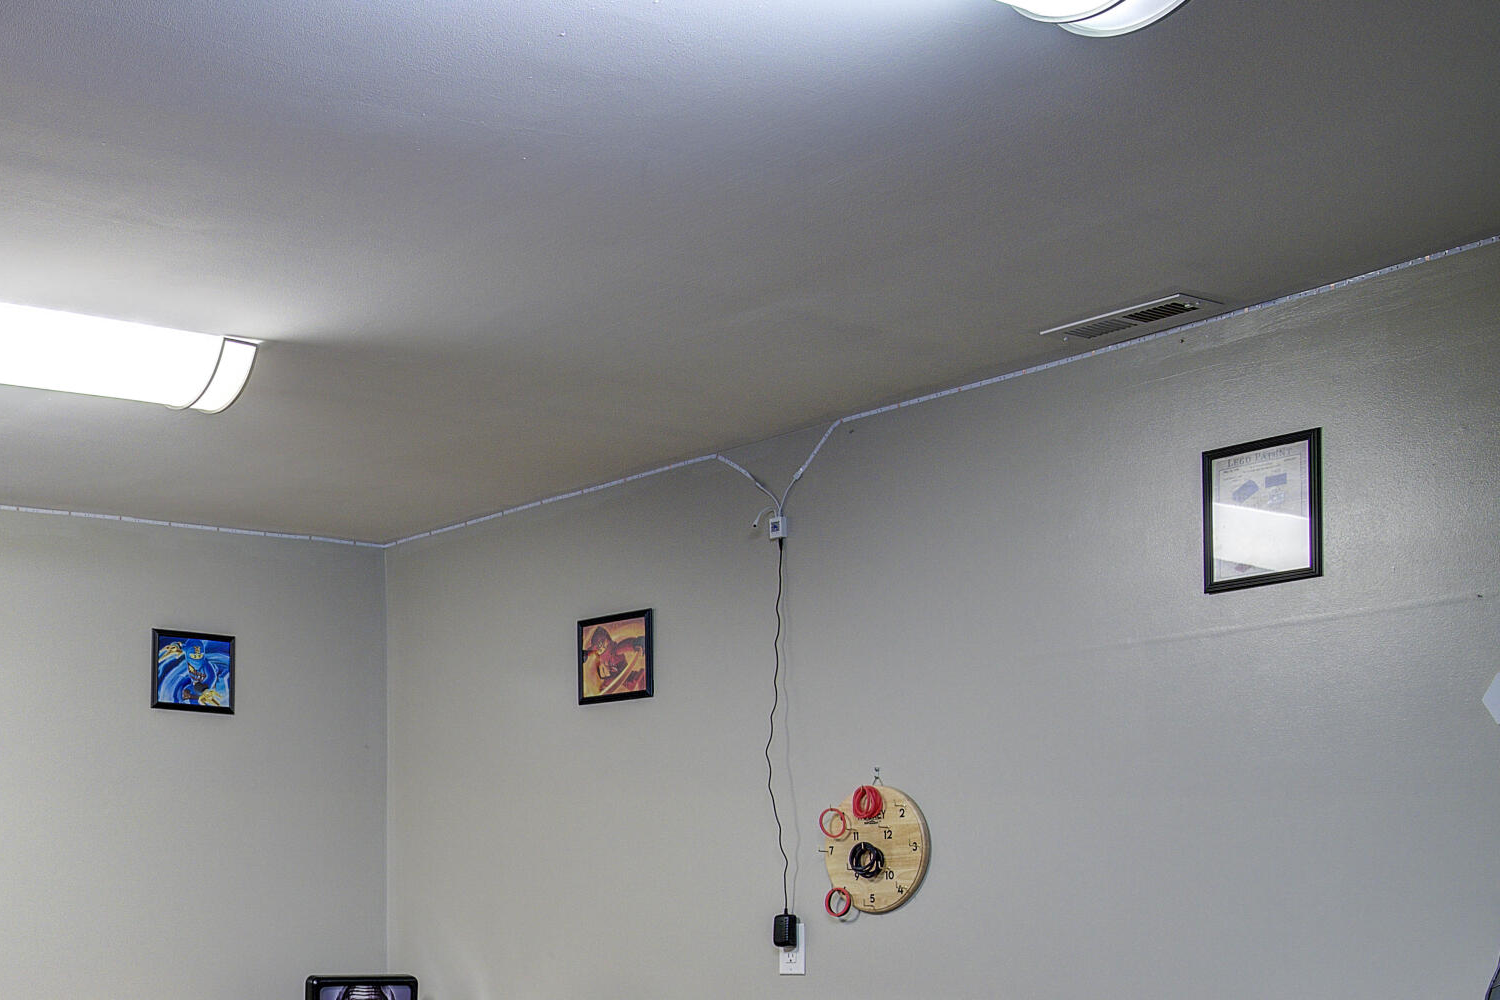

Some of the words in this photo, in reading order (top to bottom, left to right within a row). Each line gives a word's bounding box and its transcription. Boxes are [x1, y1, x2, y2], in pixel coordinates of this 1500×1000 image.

[900, 809, 905, 818] 2
[883, 829, 893, 840] 12
[828, 846, 834, 855] 7
[912, 841, 918, 851] 3
[885, 870, 895, 880] 10
[869, 893, 876, 903] 5
